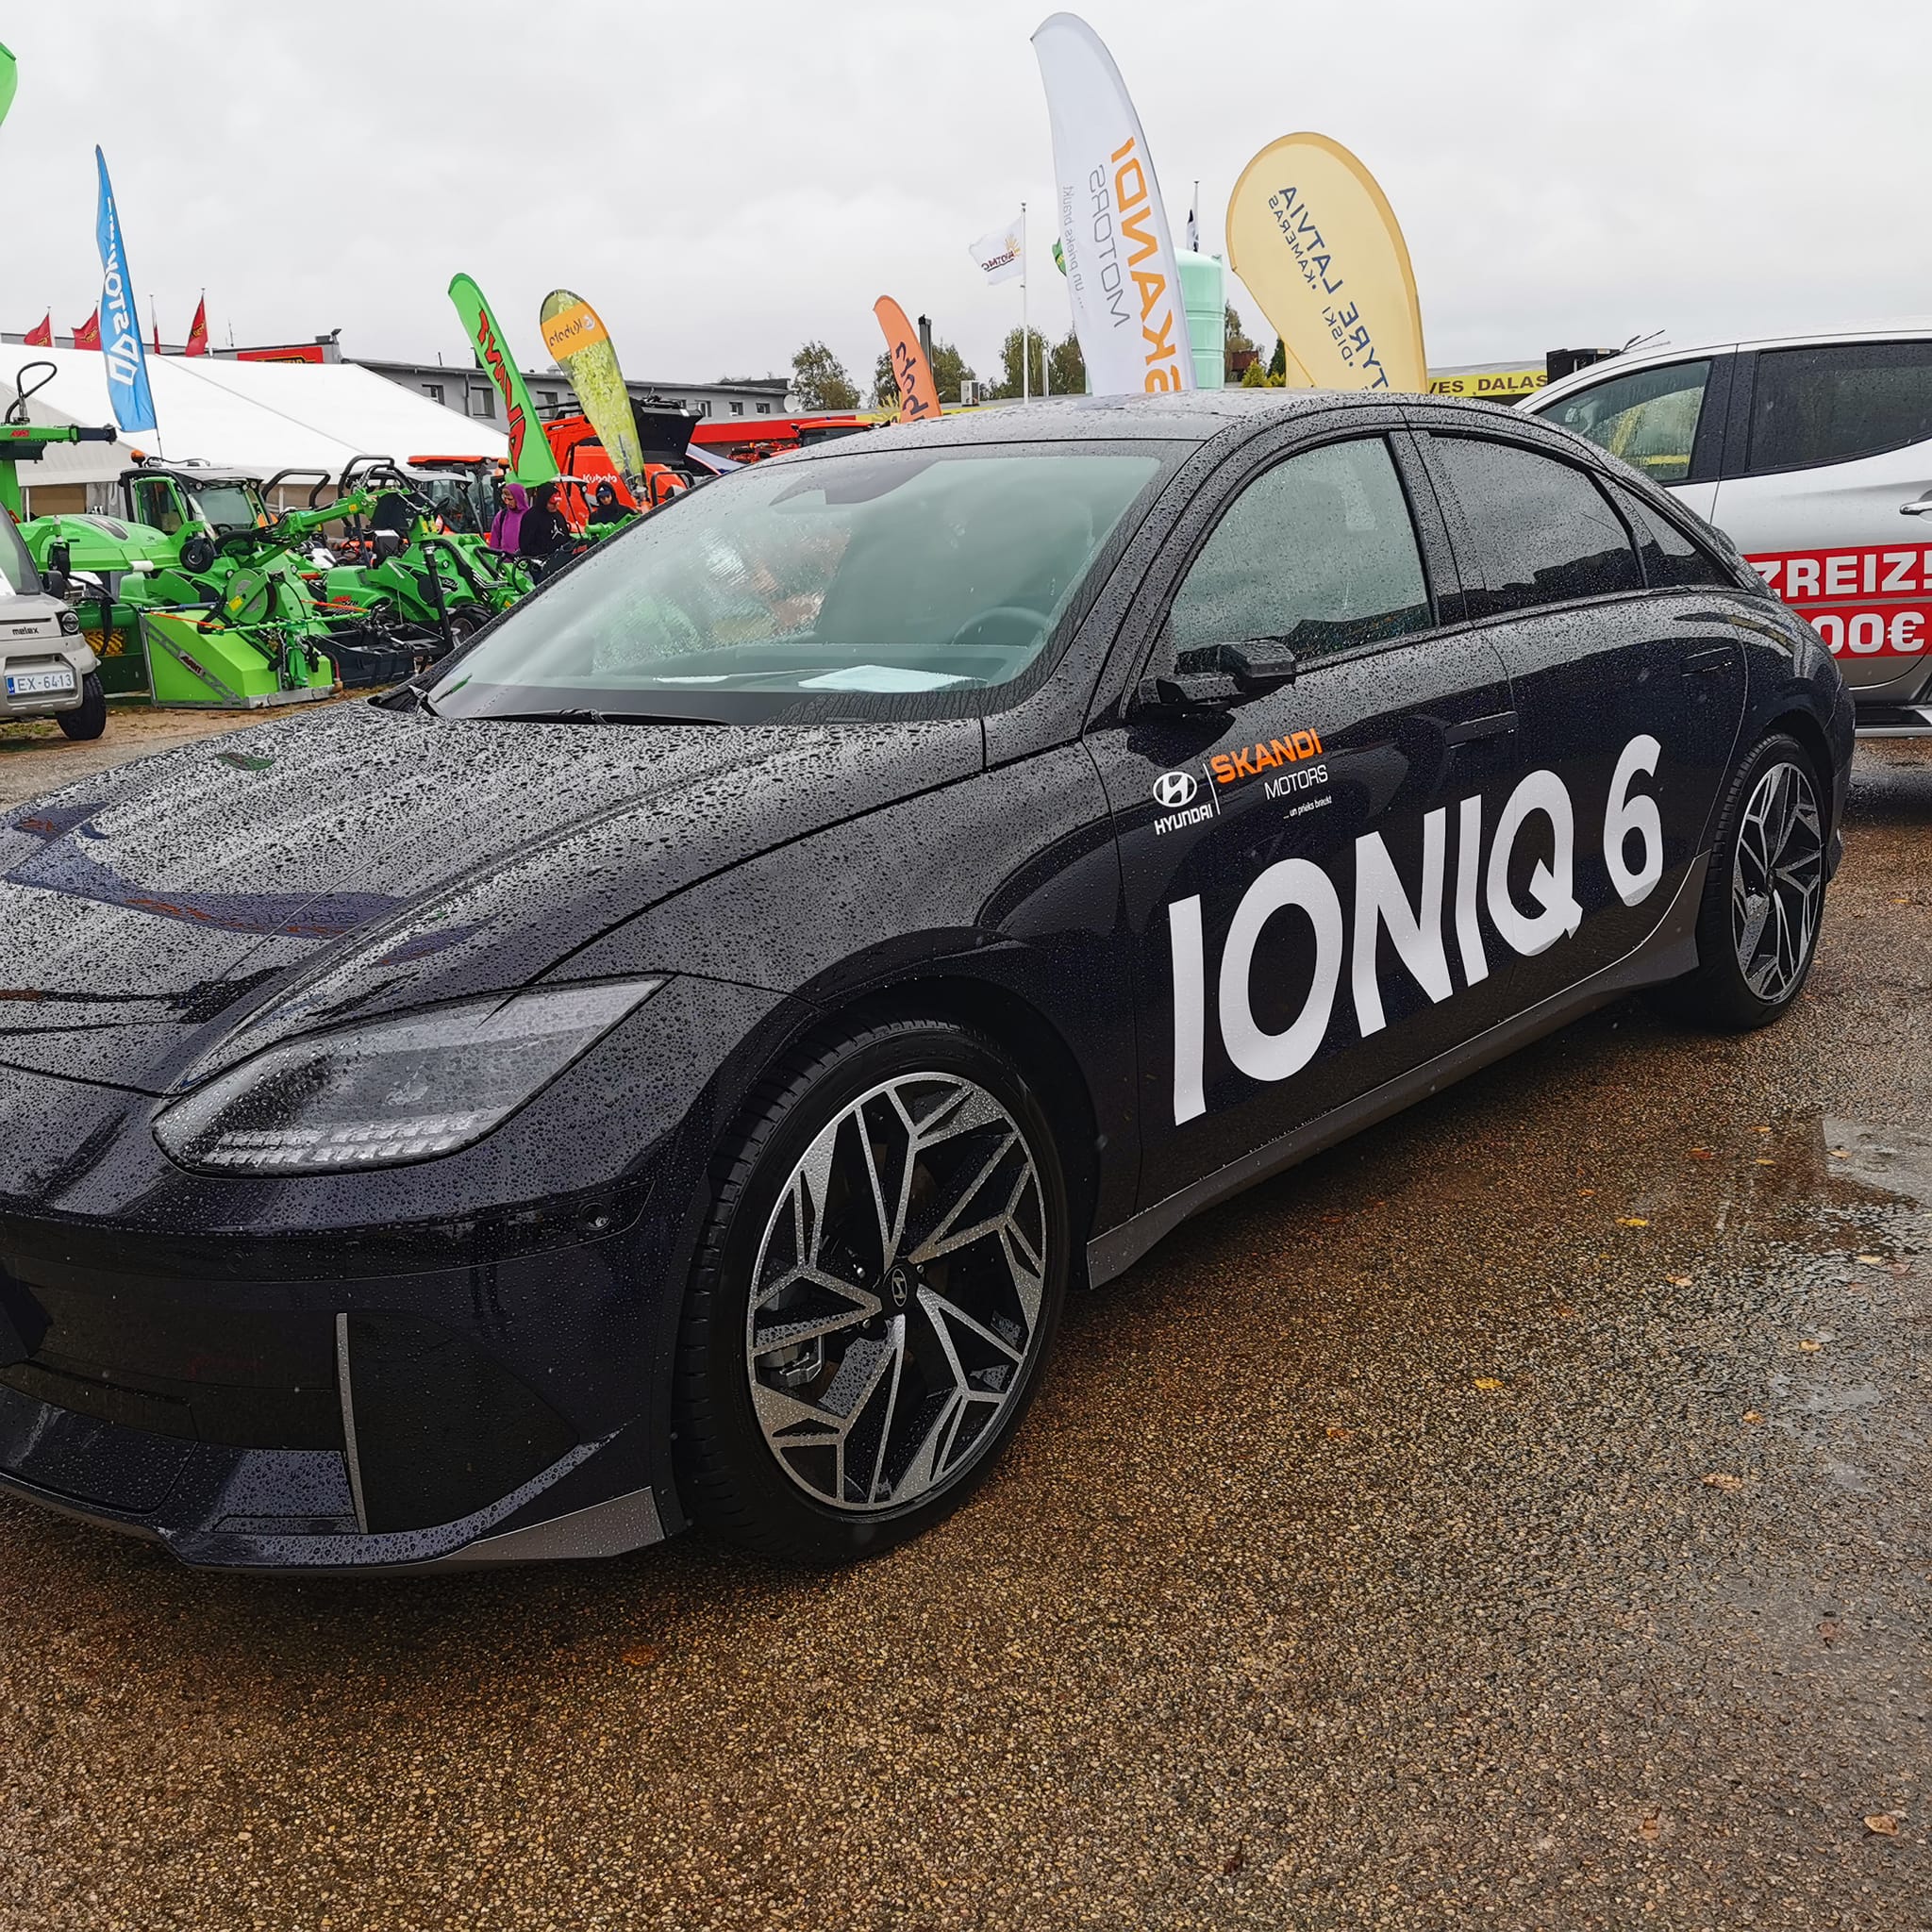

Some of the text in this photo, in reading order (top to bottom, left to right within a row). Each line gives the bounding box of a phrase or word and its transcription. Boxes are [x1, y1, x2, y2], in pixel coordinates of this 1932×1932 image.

[582, 473, 618, 483] Kubota
[1210, 727, 1324, 784] SKANDI
[1264, 764, 1328, 800] MOTORS
[1154, 804, 1213, 836] HYUNDAI
[1168, 734, 1662, 1126] IONIQ 6
